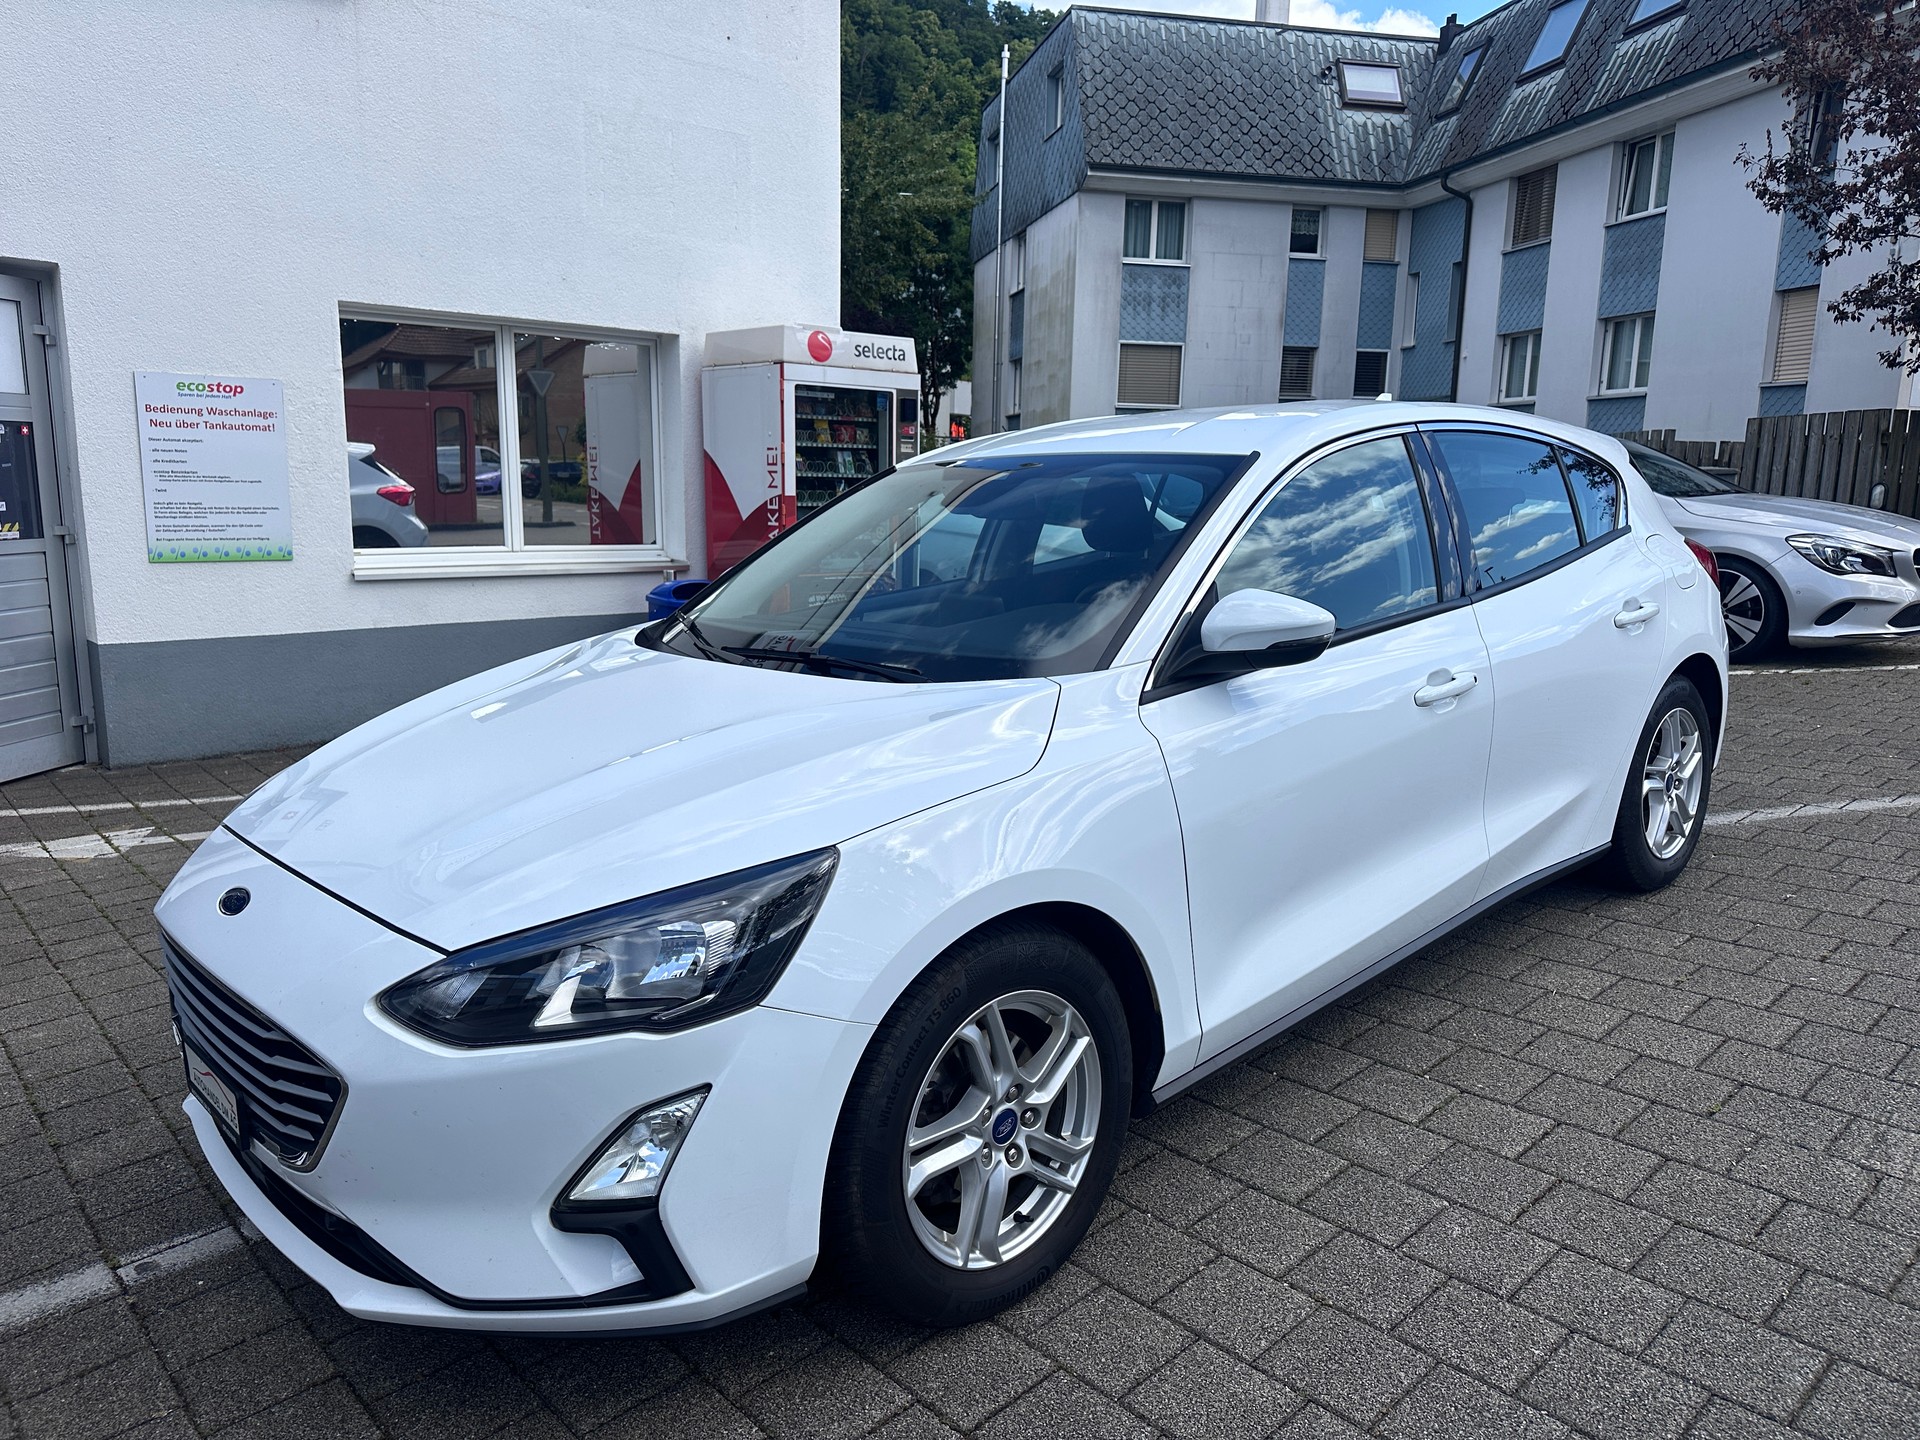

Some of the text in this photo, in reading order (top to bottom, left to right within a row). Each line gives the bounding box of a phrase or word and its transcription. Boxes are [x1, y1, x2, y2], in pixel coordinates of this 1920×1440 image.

[854, 342, 906, 362] selecta
[176, 382, 244, 397] ecostop
[145, 404, 278, 420] Bedienung Waschanlage:
[150, 419, 275, 432] Neu über Tankautomat!
[766, 446, 779, 540] AKE ME!
[925, 1008, 942, 1028] TS
[940, 986, 962, 1012] 860
